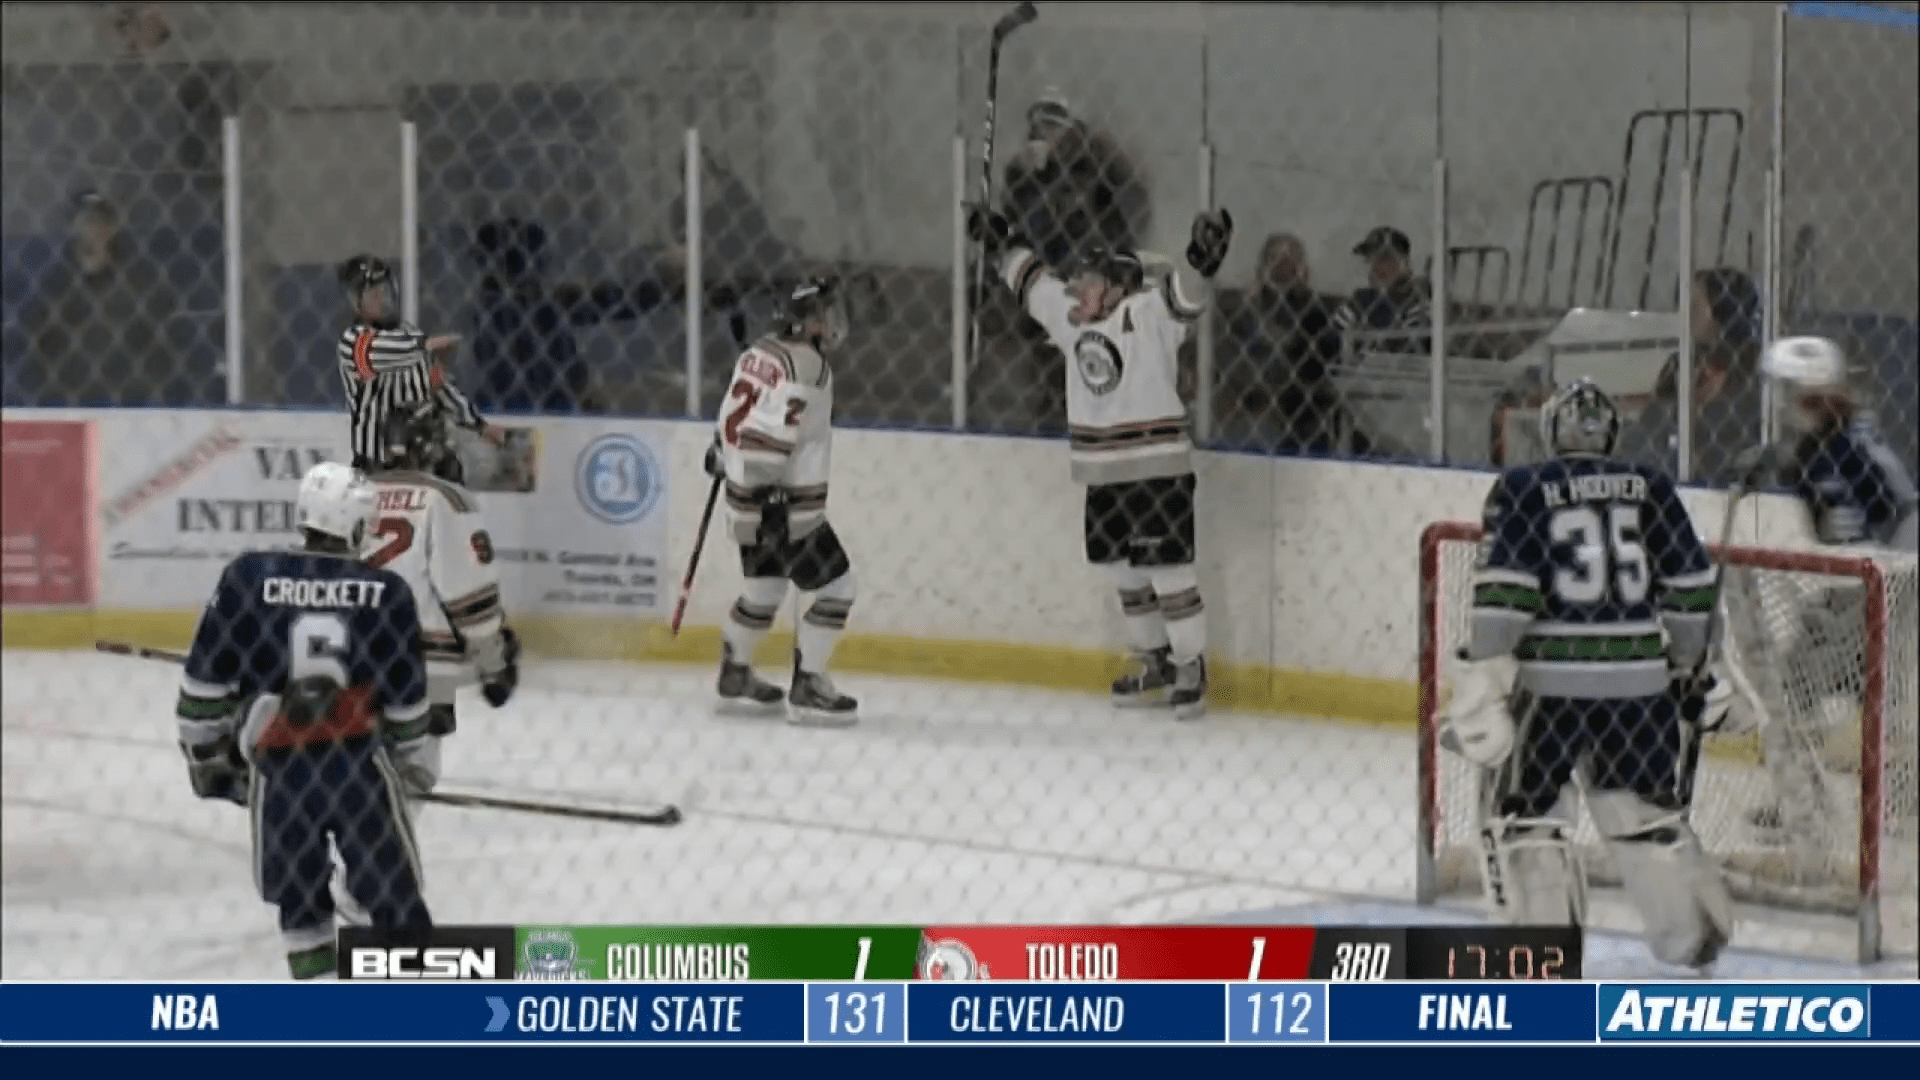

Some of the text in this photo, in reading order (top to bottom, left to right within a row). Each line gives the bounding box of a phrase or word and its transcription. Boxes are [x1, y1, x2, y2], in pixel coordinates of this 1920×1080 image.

[784, 397, 807, 427] 2
[1569, 472, 1647, 502] HOOVER
[1551, 507, 1650, 605] 35
[263, 577, 386, 609] CROCKETT
[290, 613, 347, 688] 6
